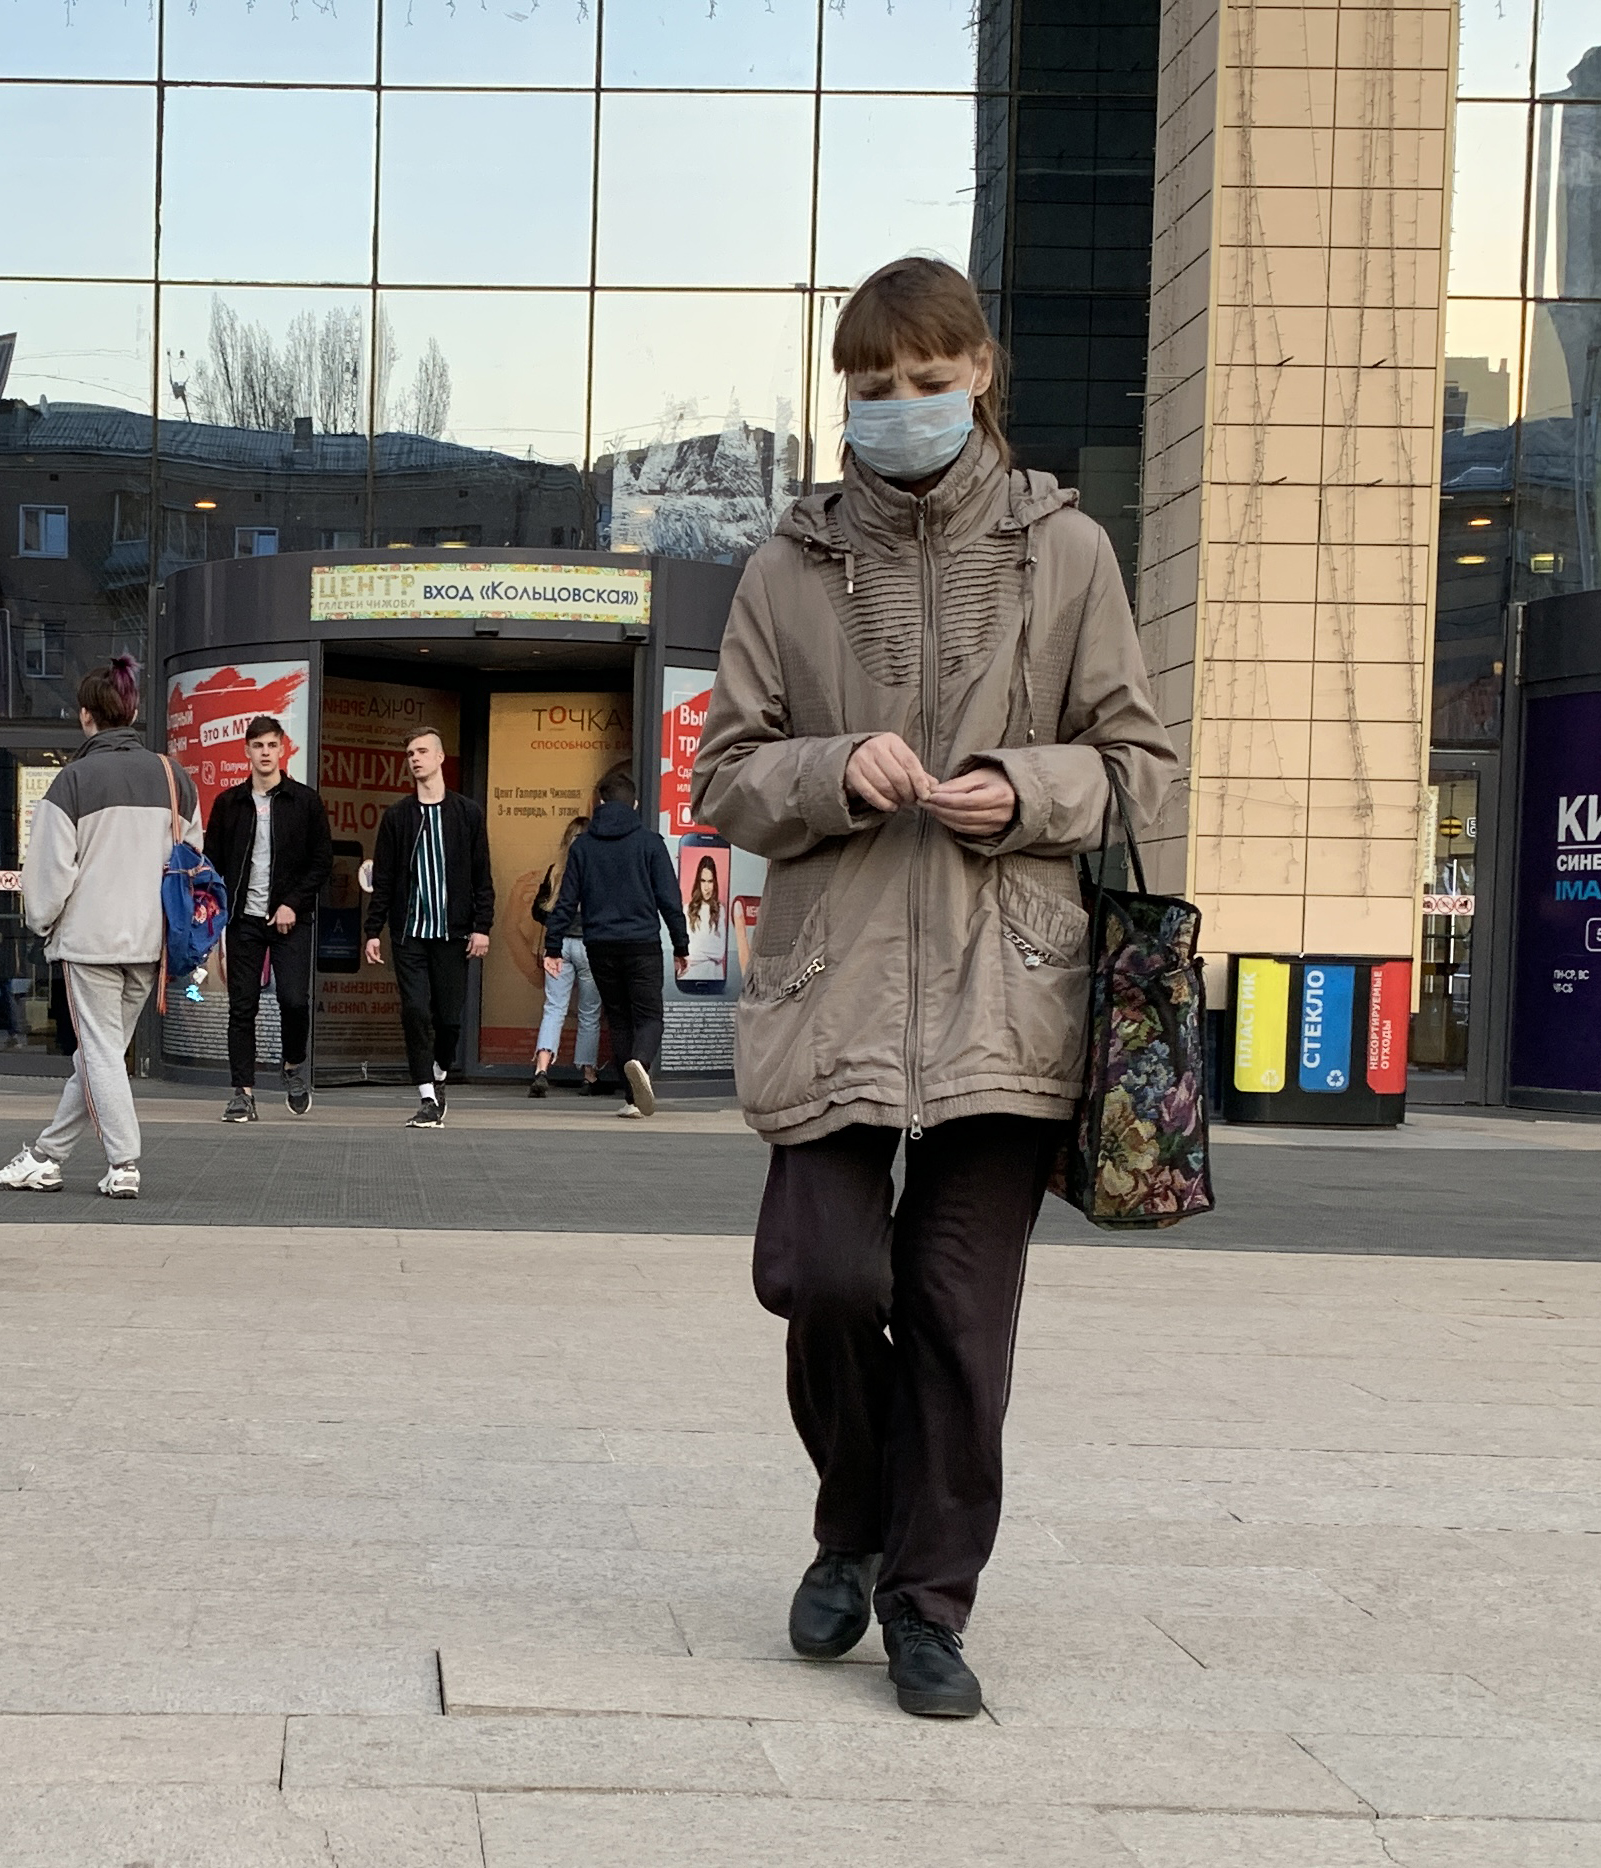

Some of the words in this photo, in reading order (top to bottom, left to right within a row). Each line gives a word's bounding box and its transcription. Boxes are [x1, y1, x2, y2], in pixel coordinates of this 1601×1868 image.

[318, 600, 363, 610] ГАЛЕРЕИ
[366, 599, 415, 609] ЧИЖОВА
[319, 574, 415, 599] ЦЕНТР
[480, 581, 639, 606] «Кольцовская»
[532, 706, 624, 732] ТОЧКА
[1237, 971, 1257, 1068] ПЛАСТИК
[1302, 970, 1325, 1068] СТЕКЛО
[1369, 971, 1383, 1070] НЕСОРТИРУЕМЫЕ
[1380, 1020, 1392, 1070] ОТХОДЫ
